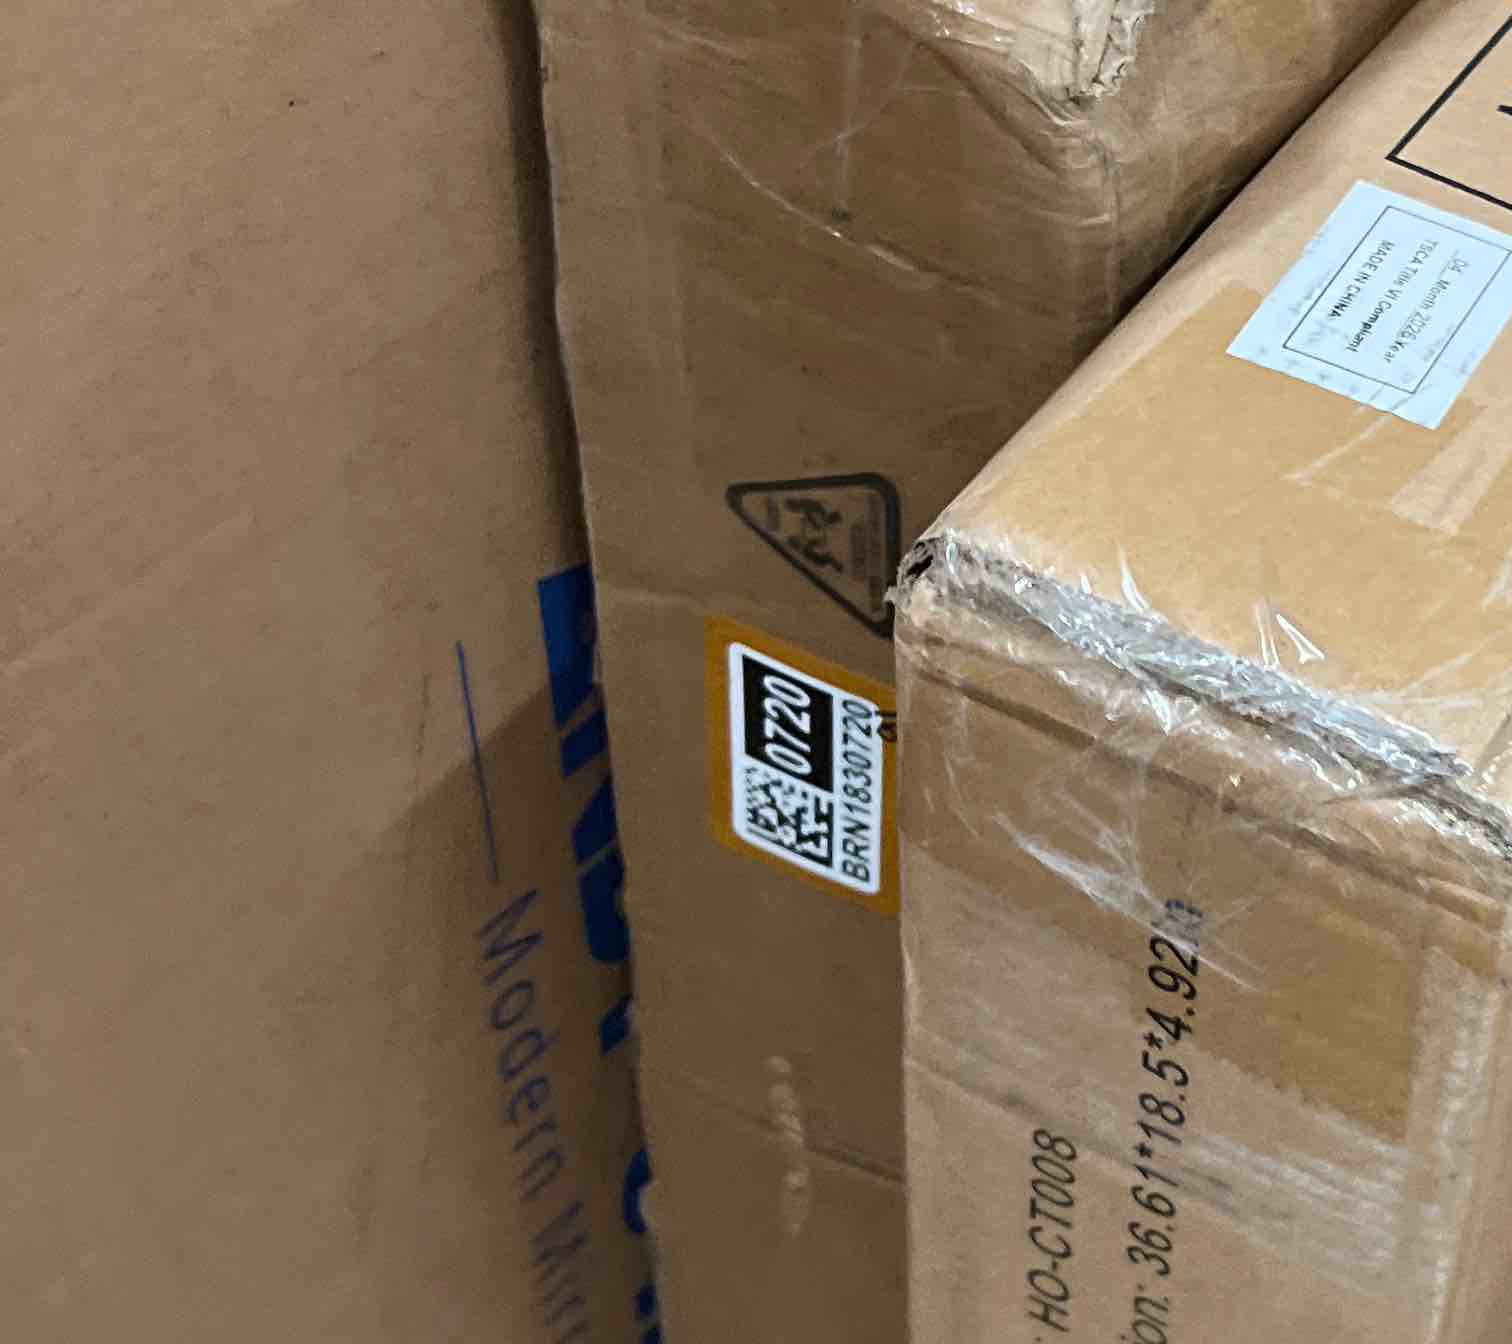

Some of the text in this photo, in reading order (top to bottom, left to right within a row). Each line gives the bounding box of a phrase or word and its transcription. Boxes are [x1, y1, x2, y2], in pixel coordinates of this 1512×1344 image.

[1328, 239, 1396, 319] MADE IN CHINA
[1410, 239, 1439, 265] TSCA
[1346, 301, 1392, 353] Compliant
[763, 673, 812, 776] 0720
[842, 699, 873, 883] BRN1830720
[475, 887, 567, 1202] Modern
[1027, 1129, 1078, 1333] HO-CT008
